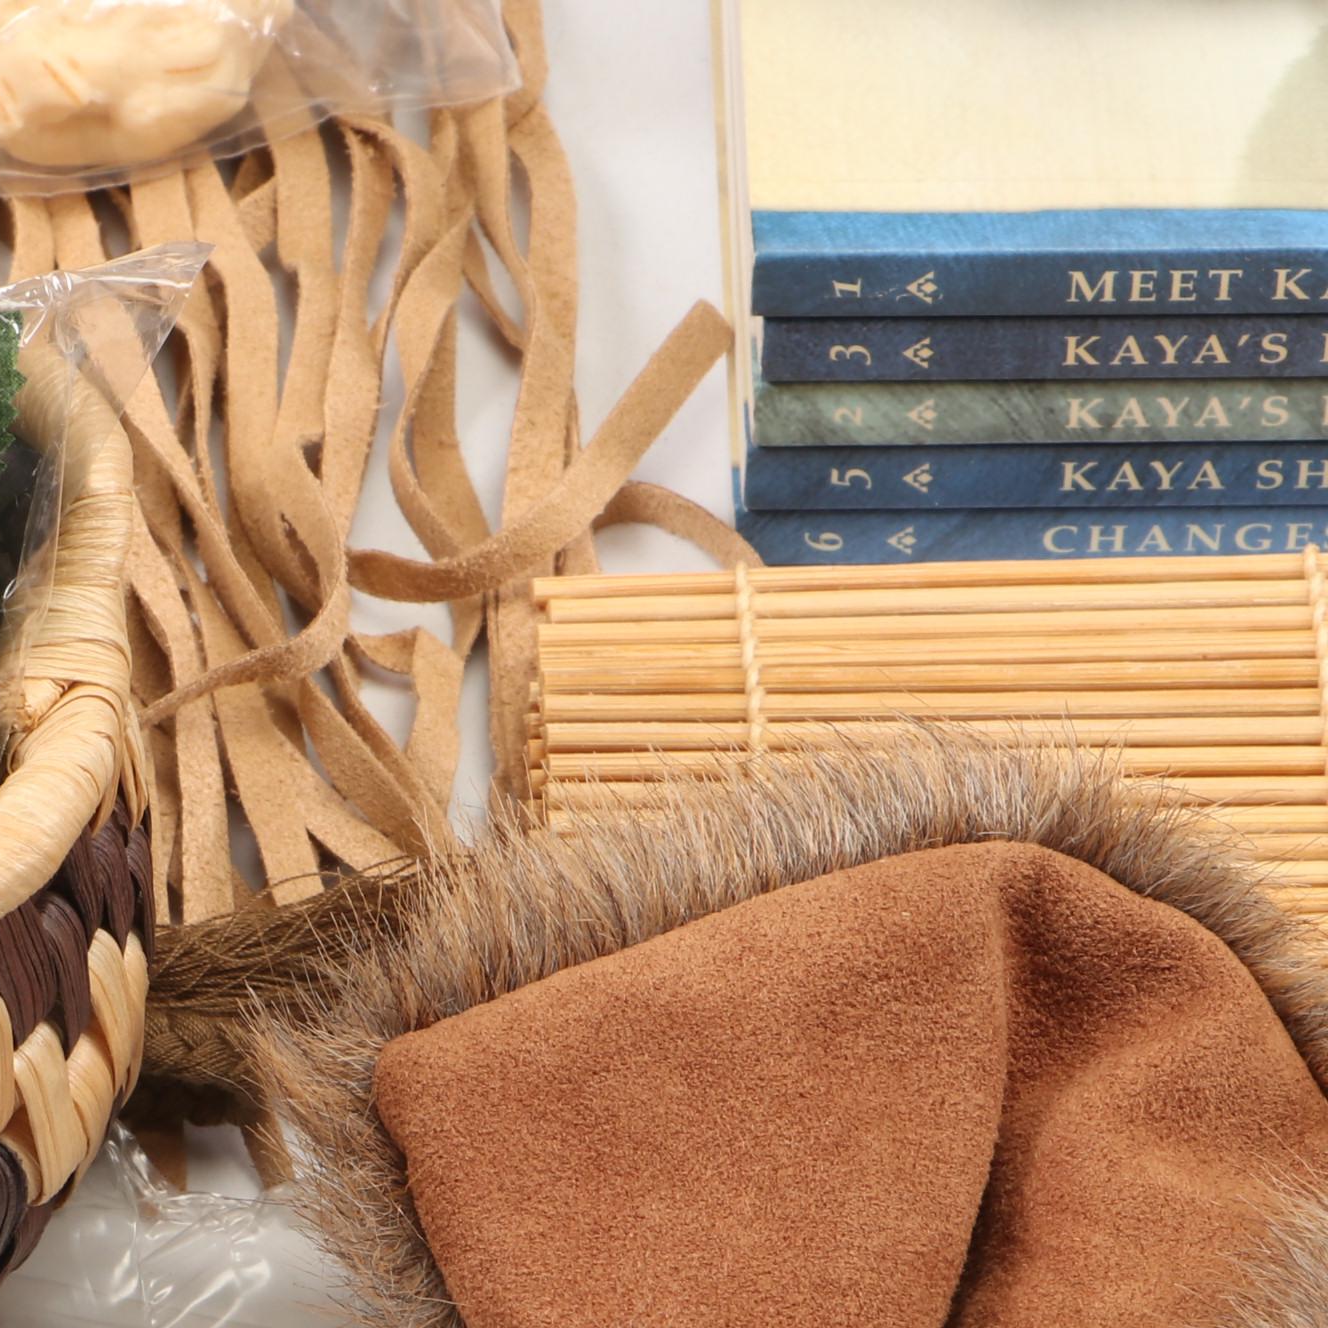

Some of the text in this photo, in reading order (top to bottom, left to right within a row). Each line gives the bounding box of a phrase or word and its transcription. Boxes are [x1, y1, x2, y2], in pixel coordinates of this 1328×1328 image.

[832, 278, 862, 298] 1
[1066, 268, 1328, 302] MEET K
[829, 344, 871, 366] 3
[1061, 332, 1288, 366] KAYA'S
[833, 406, 863, 426] 2
[1065, 395, 1289, 429] KAYA'S
[830, 467, 872, 490] 5
[1059, 460, 1225, 491] KAYA
[804, 532, 843, 551] 6
[1042, 523, 1328, 553] CHANGE
